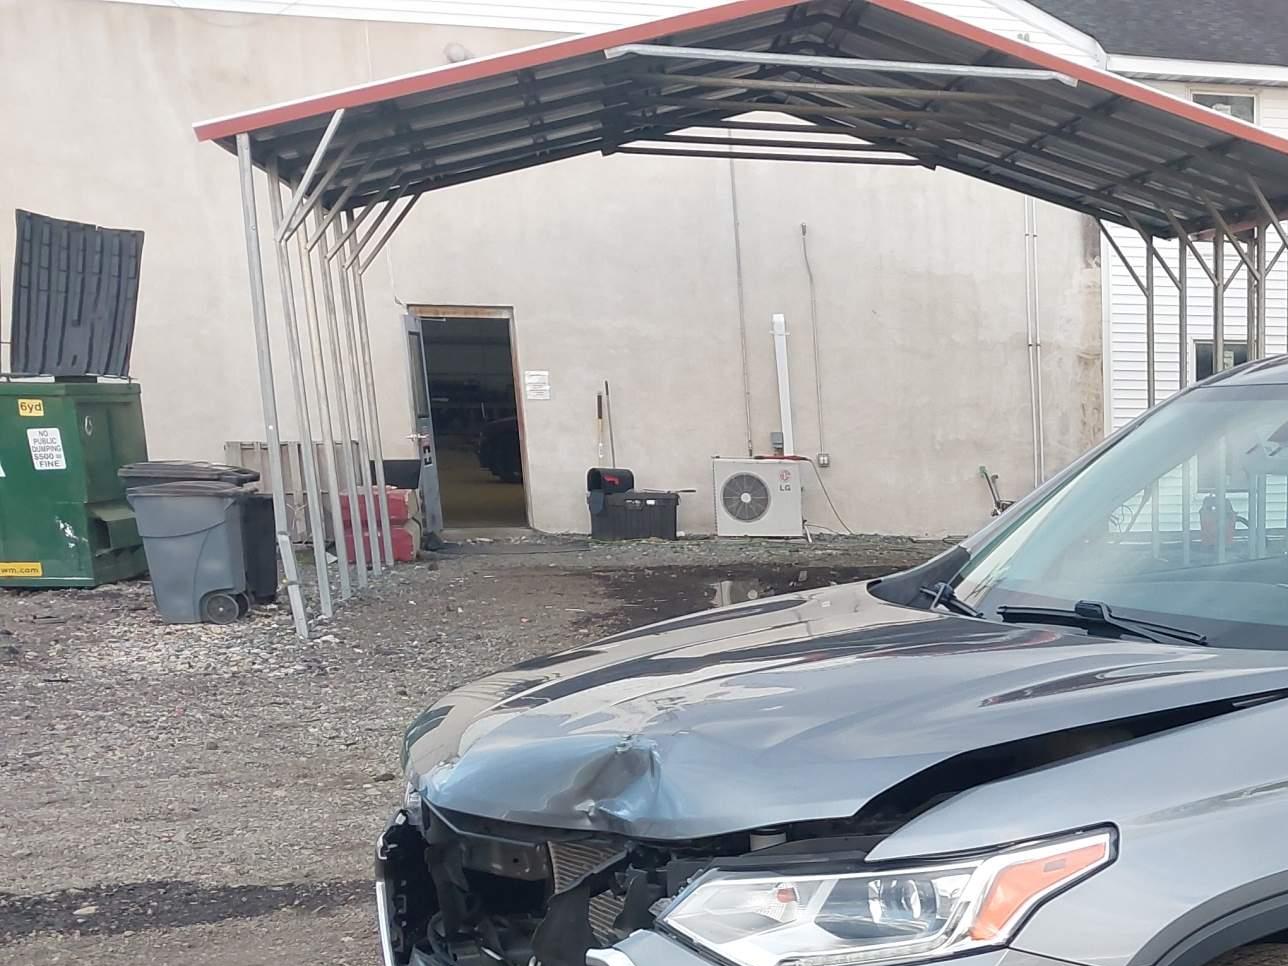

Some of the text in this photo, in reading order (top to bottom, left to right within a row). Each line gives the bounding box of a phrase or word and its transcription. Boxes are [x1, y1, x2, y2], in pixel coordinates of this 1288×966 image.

[20, 402, 42, 413] 6yd
[33, 437, 57, 445] PUBLIC
[32, 445, 62, 453] DUMPING
[39, 460, 61, 468] FINE
[779, 484, 792, 492] LG
